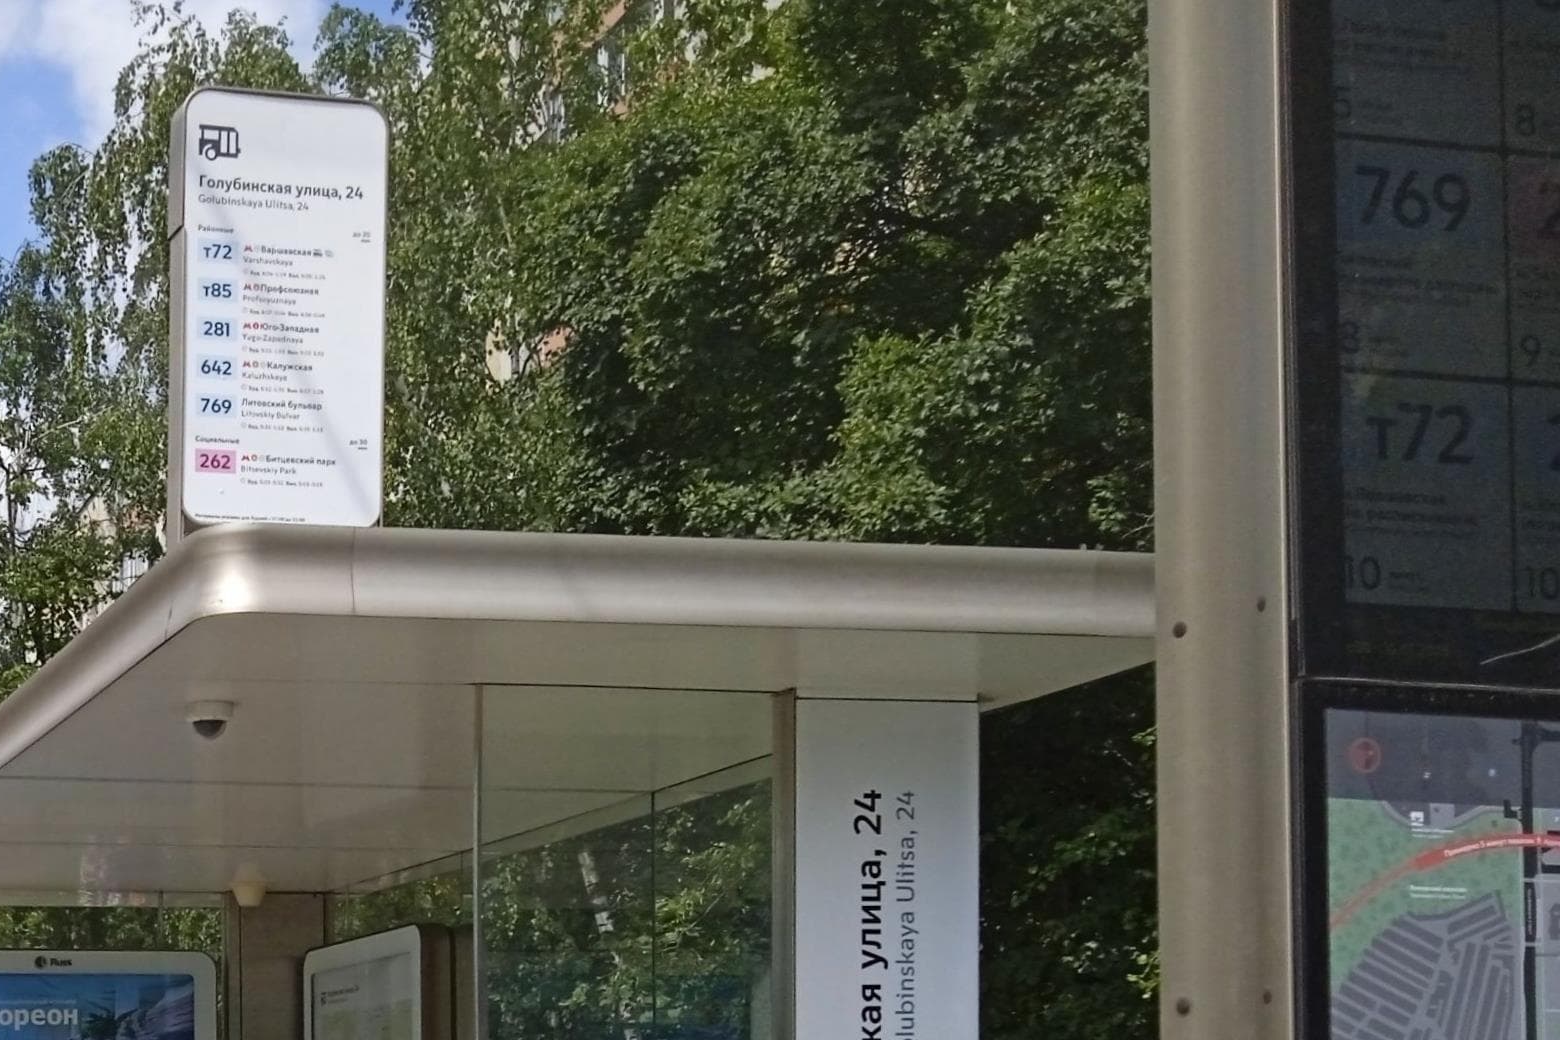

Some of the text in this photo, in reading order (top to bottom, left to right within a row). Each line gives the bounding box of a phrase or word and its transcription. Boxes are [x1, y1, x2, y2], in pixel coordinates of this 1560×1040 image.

[199, 174, 364, 200] Голубинская улица, 24
[198, 194, 309, 211] Golubinskaya Ulitsa, 24
[1355, 165, 1471, 231] 769
[203, 244, 232, 260] т72
[203, 283, 232, 298] т85
[203, 321, 230, 337] 281
[261, 321, 320, 334] Юго-Западная
[201, 359, 232, 376] 642
[266, 361, 313, 373] Калужская
[201, 398, 232, 414] 769
[241, 398, 286, 409] Литовский
[1365, 402, 1474, 465] т72
[199, 453, 231, 469] 262
[266, 454, 336, 467] Битцевский парк
[853, 789, 883, 835] 24
[896, 791, 916, 820] 24
[895, 830, 919, 902] Ulitsa,
[860, 848, 889, 969] улица,
